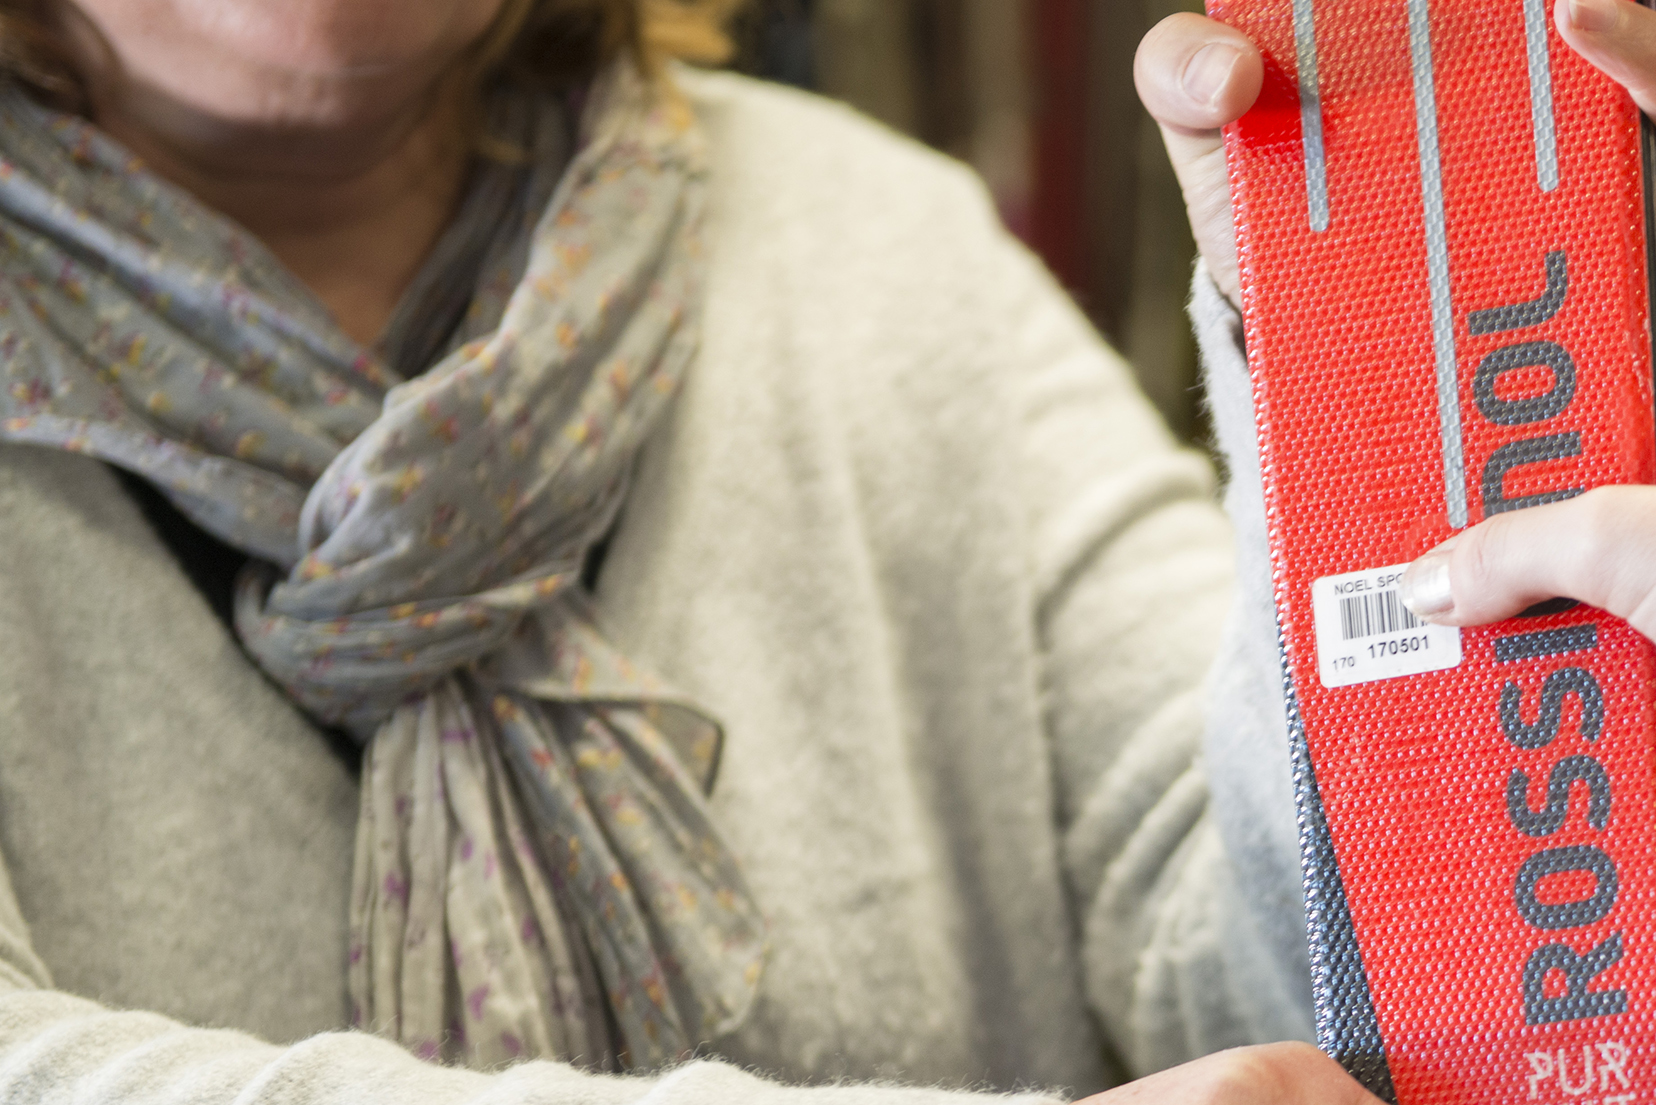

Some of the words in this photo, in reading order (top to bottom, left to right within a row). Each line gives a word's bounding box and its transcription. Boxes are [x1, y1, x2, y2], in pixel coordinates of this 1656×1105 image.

[1334, 579, 1372, 595] NOEL
[1367, 634, 1430, 658] 170501
[1467, 249, 1632, 1026] ROSSINOL
[1332, 656, 1356, 672] 170
[1525, 1041, 1630, 1099] PUR
